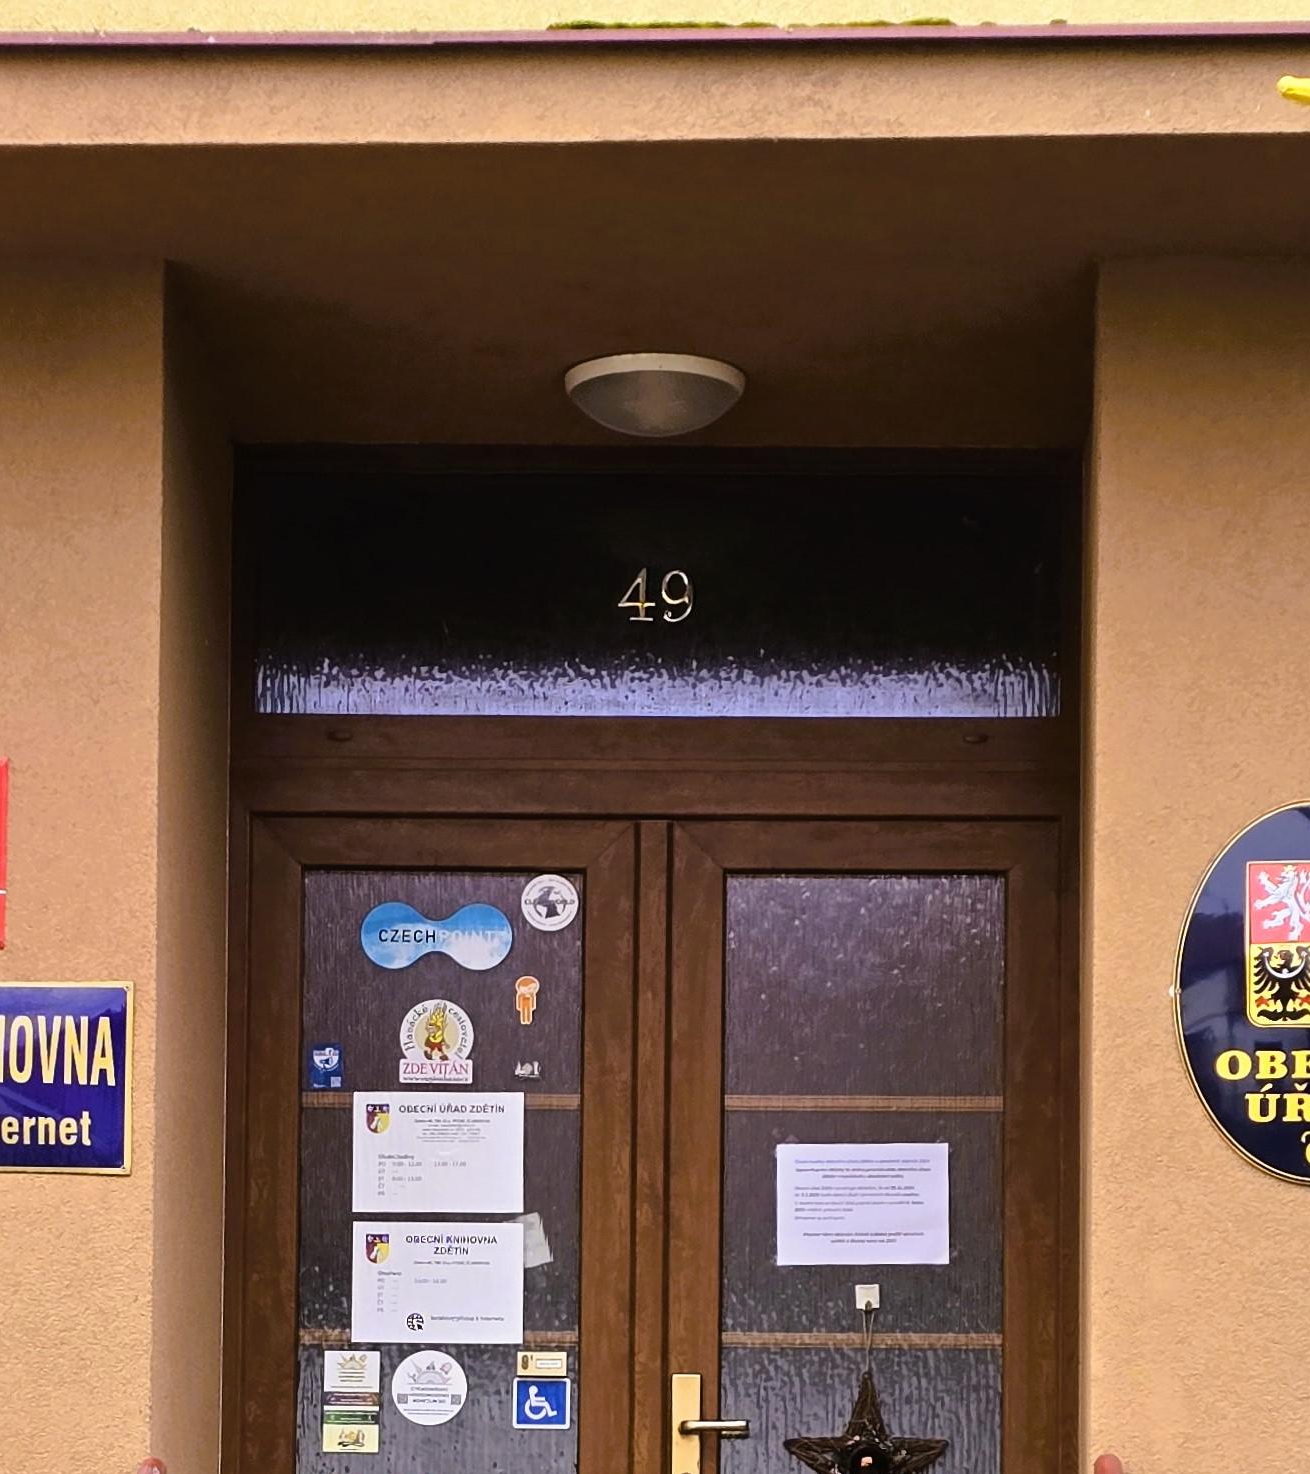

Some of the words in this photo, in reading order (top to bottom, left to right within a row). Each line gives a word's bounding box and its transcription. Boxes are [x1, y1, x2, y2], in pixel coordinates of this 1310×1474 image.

[617, 567, 694, 623] 49
[378, 928, 436, 944] CZECH
[403, 1062, 427, 1075] ZDE
[398, 1103, 437, 1114] OBECNÍ
[439, 1102, 467, 1114] ÚŘAD
[469, 1103, 505, 1114] ZDĚTÍN
[405, 1233, 444, 1245] OBECNÍ
[446, 1235, 498, 1245] KNIHOVNA
[433, 1246, 469, 1256] ZDĚTÍN
